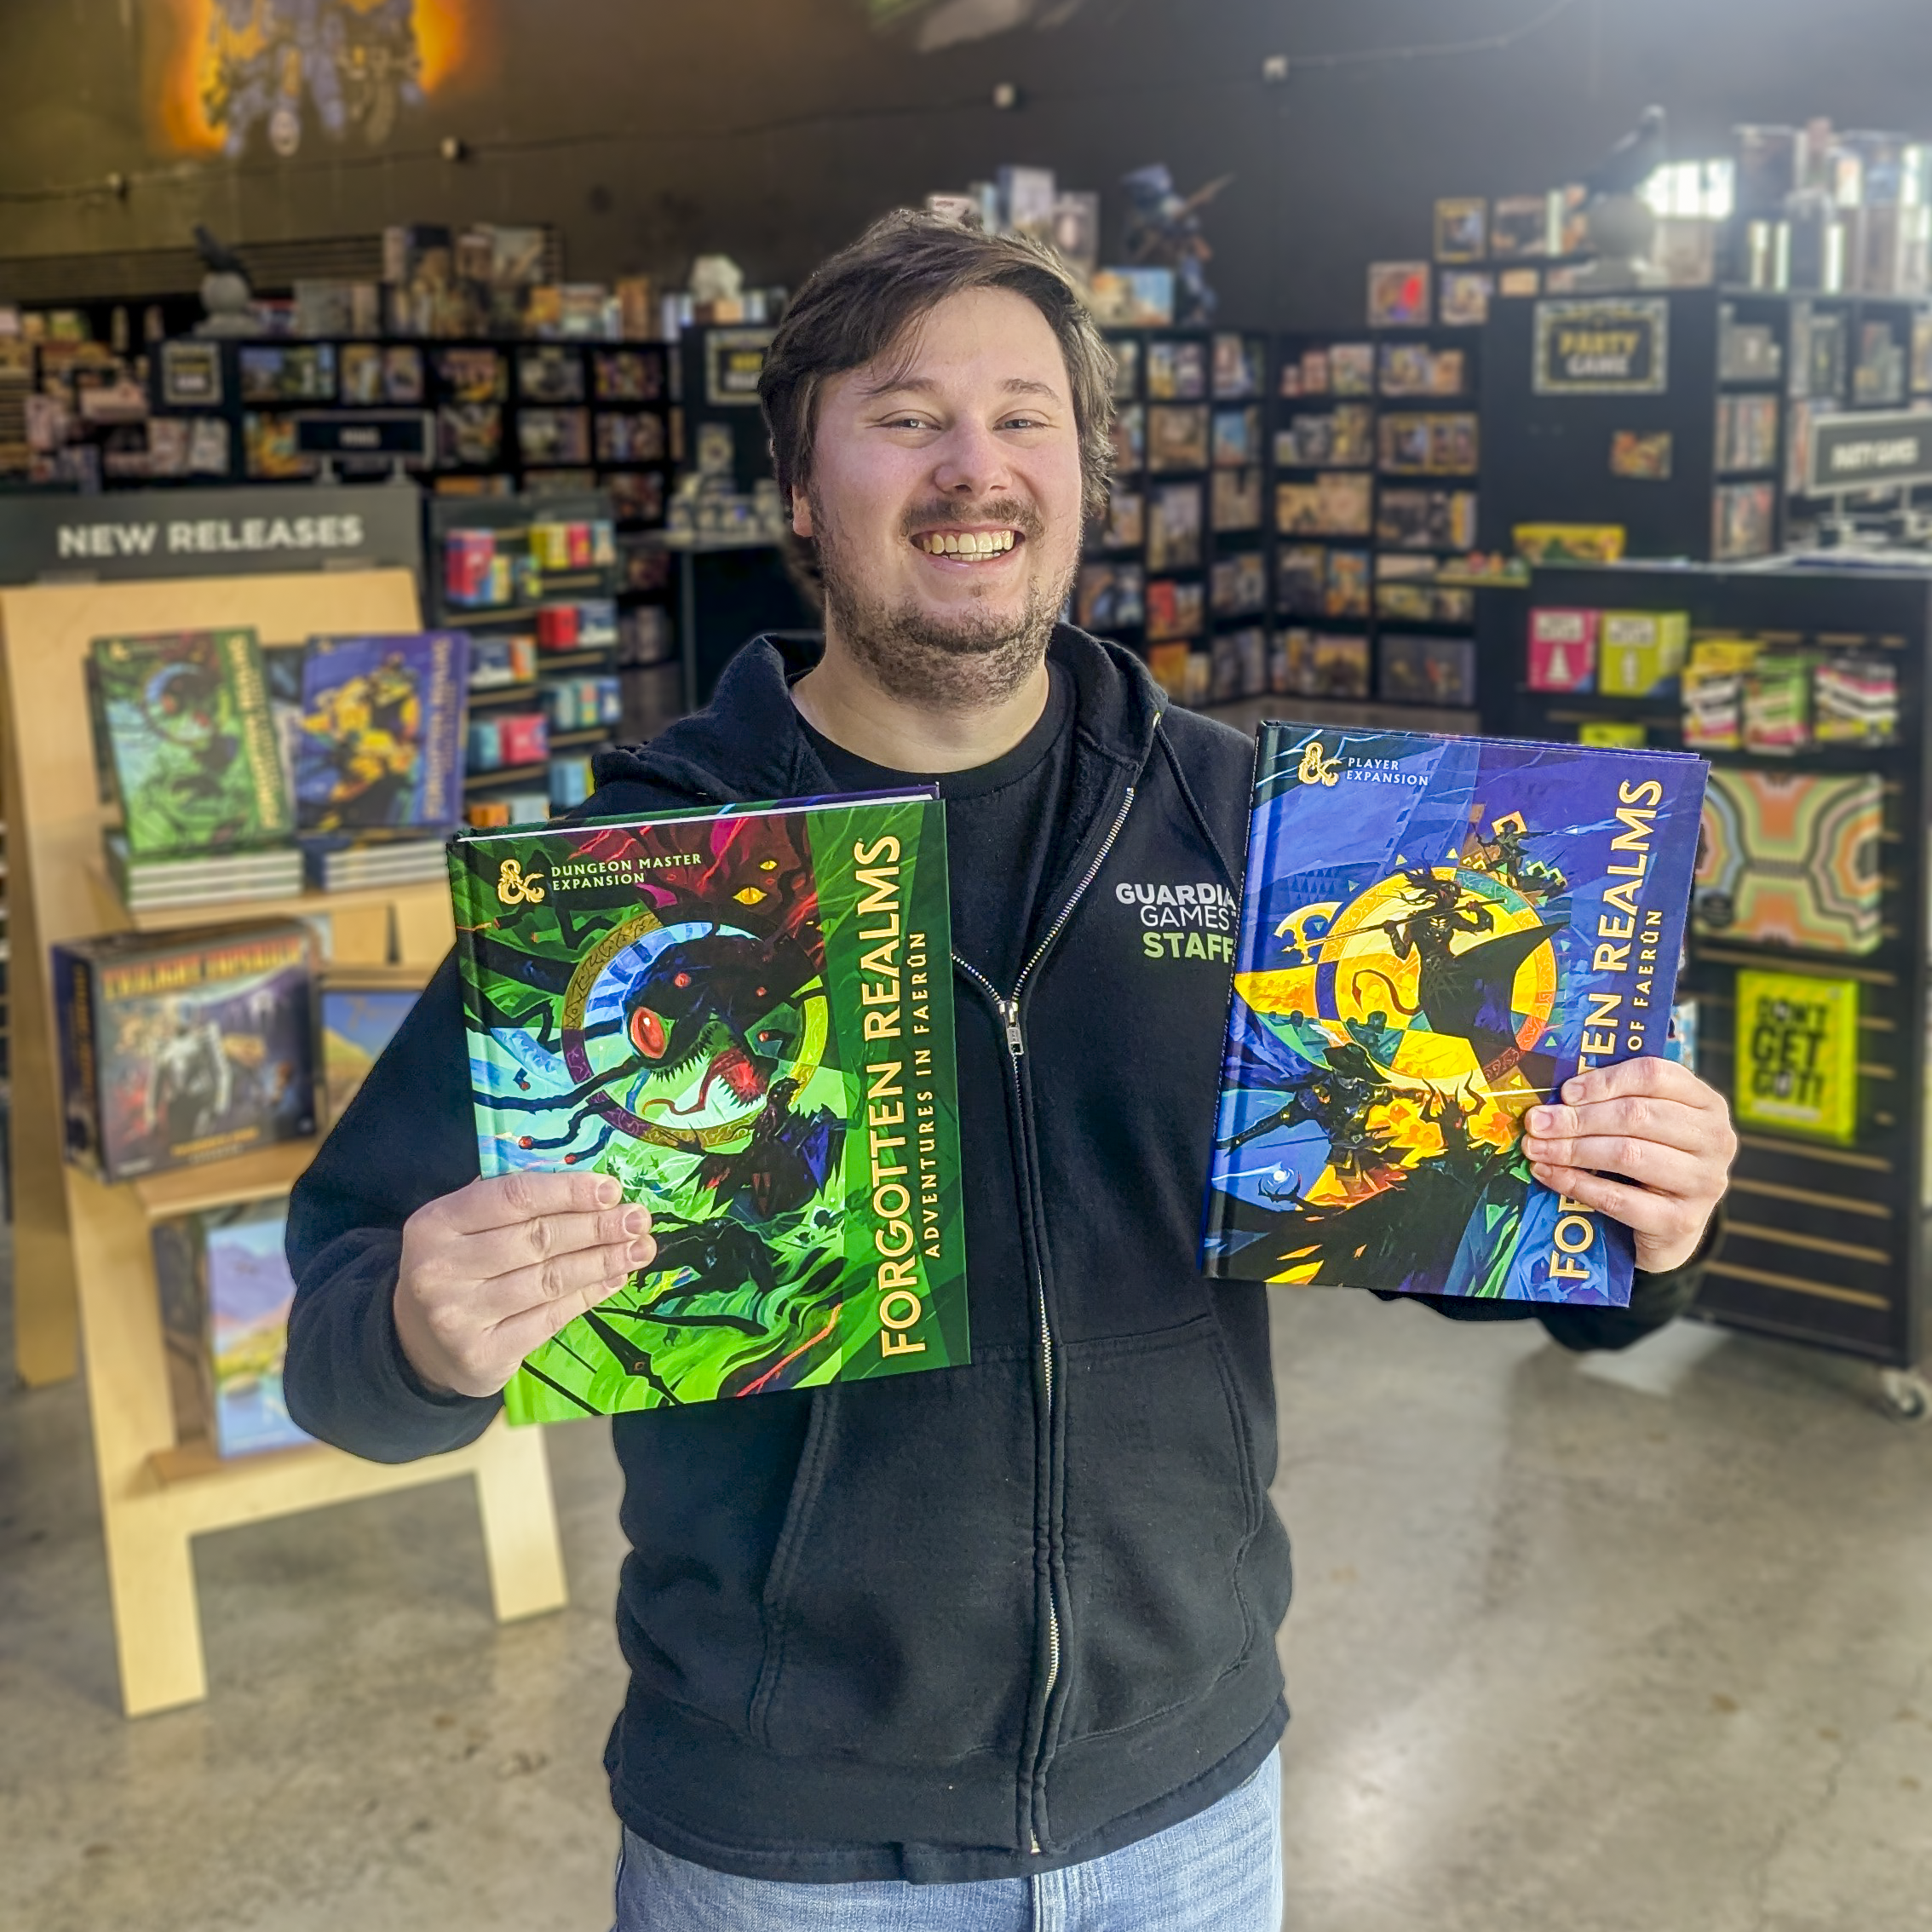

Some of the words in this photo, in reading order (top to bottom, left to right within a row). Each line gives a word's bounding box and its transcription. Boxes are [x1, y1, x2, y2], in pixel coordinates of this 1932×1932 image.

[57, 522, 158, 556] NEW
[168, 515, 364, 554] RELEASES
[1346, 770, 1429, 785] EXPANSION
[1348, 757, 1399, 771] PLAYER
[551, 860, 632, 877] DUNGEON
[639, 854, 702, 870] MASTER
[1593, 779, 1662, 971] REALMS
[553, 872, 645, 891] EXPANSION
[1116, 883, 1236, 910] GUARDIA
[854, 835, 900, 1041] REALMS
[1143, 932, 1233, 963] STAFF
[1628, 1021, 1645, 1051] OF
[1751, 1026, 1826, 1072] GET
[915, 1049, 932, 1076] IN
[917, 1090, 940, 1258] ADVENTURES
[866, 1061, 925, 1358] FORGOTTEN
